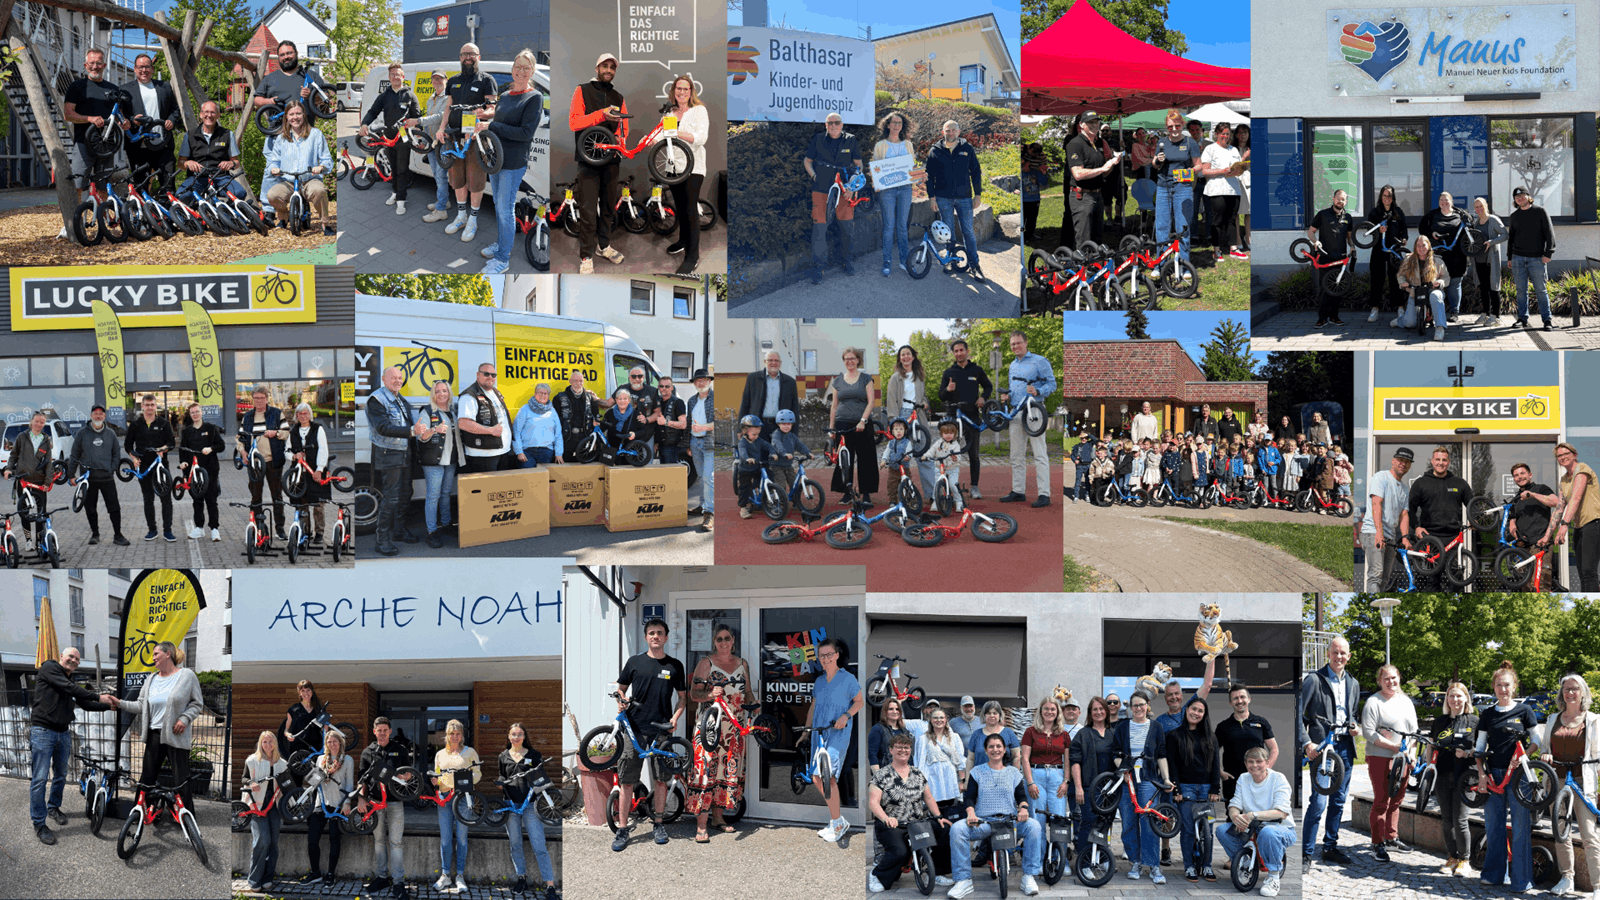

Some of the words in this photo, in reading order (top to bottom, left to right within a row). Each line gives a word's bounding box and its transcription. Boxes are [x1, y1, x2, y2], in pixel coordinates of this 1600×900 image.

[629, 5, 676, 17] EINFACH
[630, 17, 652, 29] DAS
[630, 30, 680, 41] RICHTIGE
[630, 42, 654, 53] RAD
[769, 38, 853, 68] Balthasar
[1418, 31, 1526, 77] Manus
[1445, 68, 1475, 76] Manuel
[1476, 68, 1500, 76] Neuer
[1502, 67, 1519, 75] Kids
[1520, 66, 1565, 74] Foundation
[769, 71, 818, 89] Kinder-
[821, 76, 843, 92] und
[768, 92, 854, 115] Jugendhospiz
[33, 285, 148, 308] LUCKY
[157, 282, 240, 305] BIKE
[504, 347, 565, 363] EINFACH
[568, 352, 594, 366] DAS
[505, 365, 569, 381] RICHTIGE
[1390, 402, 1458, 416] LUCKY
[1462, 402, 1512, 415] BIKE
[563, 500, 592, 511] KTM
[636, 503, 664, 514] KTM
[490, 509, 522, 523] KTM
[150, 581, 186, 595] EINFACH
[149, 594, 167, 605] DAS
[149, 601, 188, 615] RICHTIGE
[268, 597, 420, 632] ARCHE
[438, 590, 563, 631] NOAH
[651, 605, 656, 616] 1
[148, 613, 167, 624] RAD
[786, 626, 827, 650] KIN
